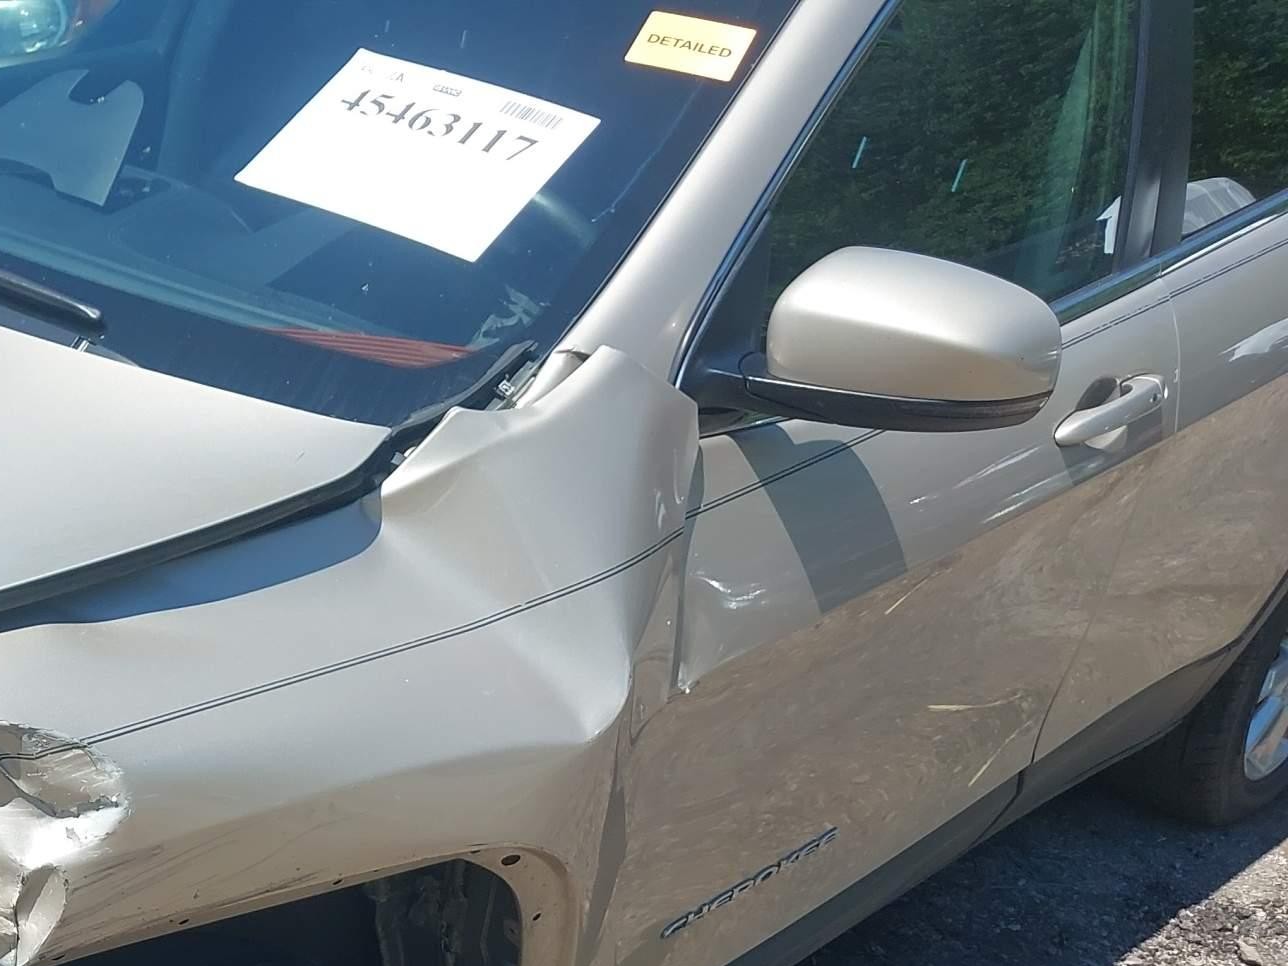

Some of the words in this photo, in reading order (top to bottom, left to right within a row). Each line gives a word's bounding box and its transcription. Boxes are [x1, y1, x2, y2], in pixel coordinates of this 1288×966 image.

[647, 33, 732, 58] DETAILED
[341, 89, 539, 161] 45463117
[660, 826, 839, 939] CHEROKEE
